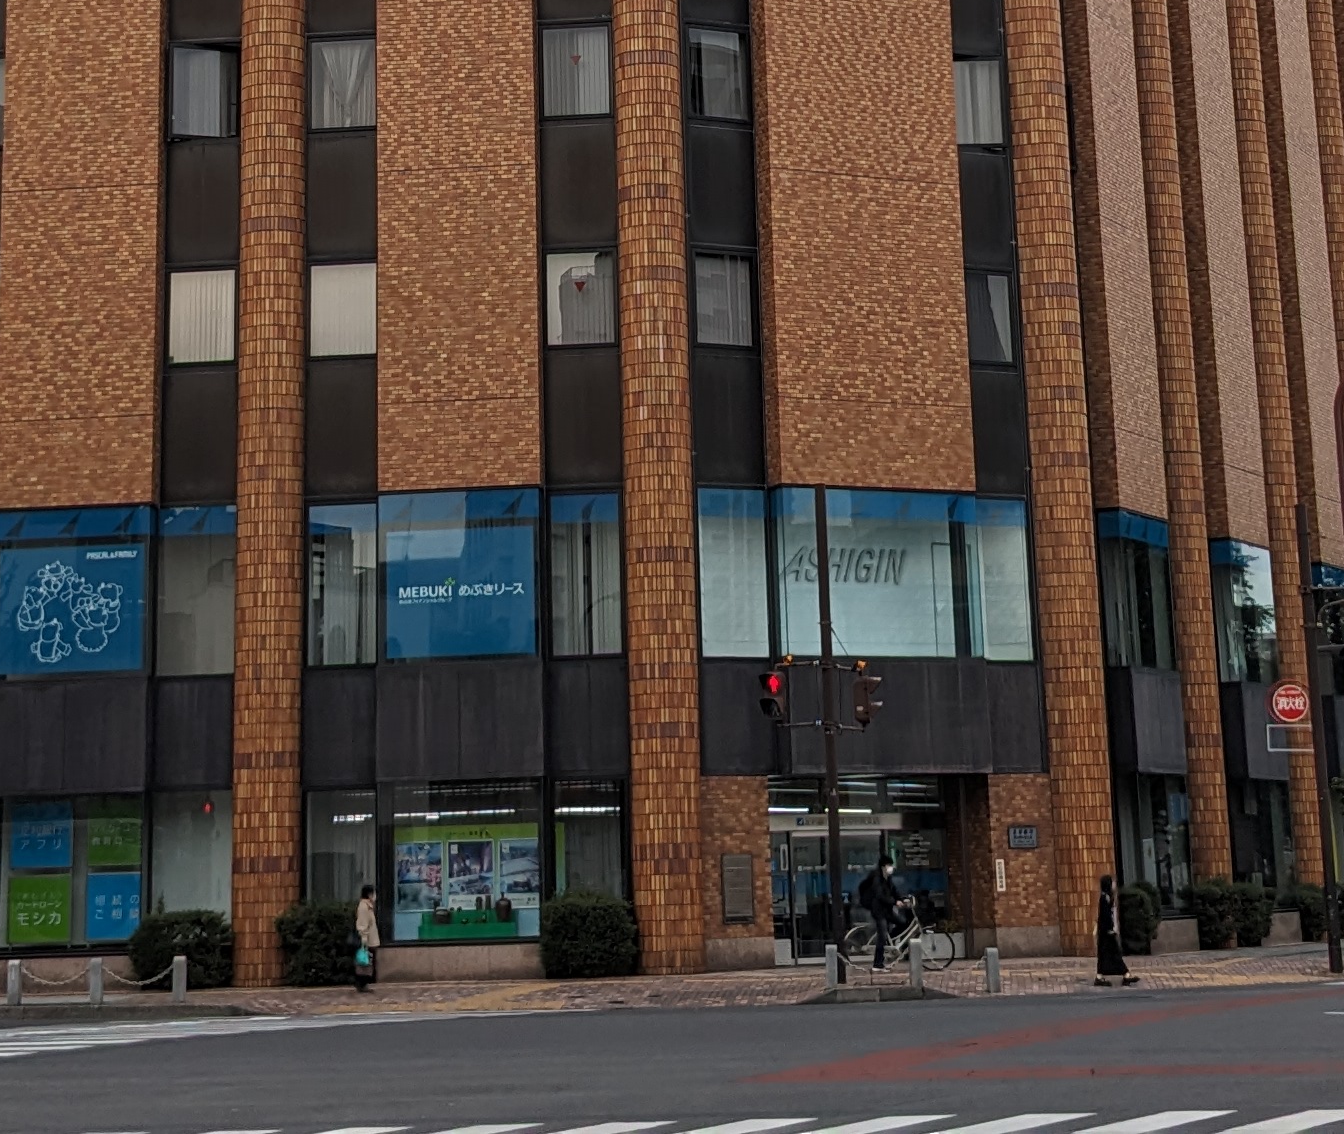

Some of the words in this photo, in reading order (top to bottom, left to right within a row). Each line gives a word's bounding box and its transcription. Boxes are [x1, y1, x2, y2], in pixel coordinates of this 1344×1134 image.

[779, 546, 907, 586] ASHIGIN
[398, 585, 453, 598] MEBUKI
[458, 583, 525, 596] めぶきリース
[1276, 696, 1305, 710] 消火栓
[17, 912, 62, 926] モシカ
